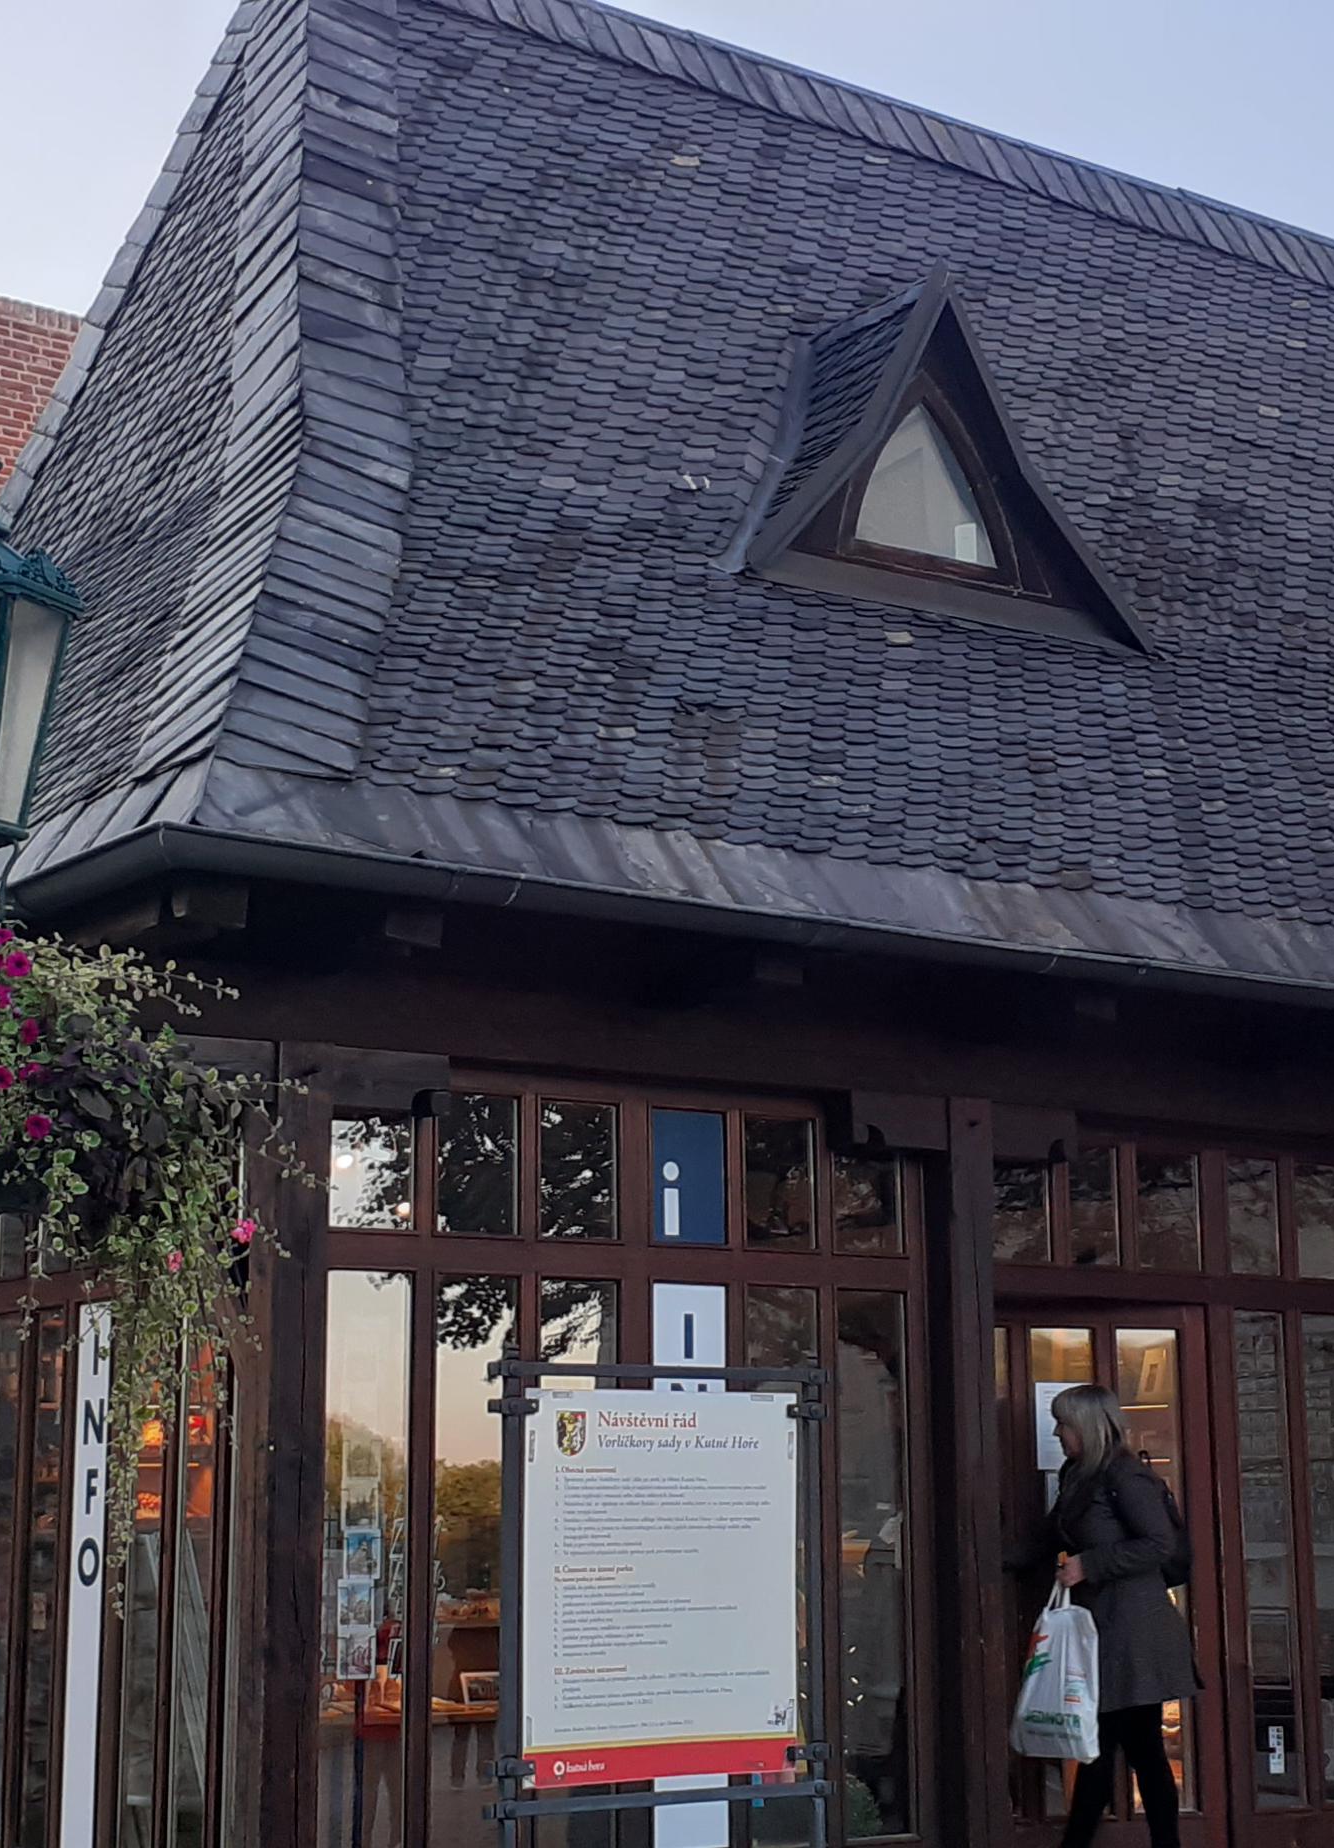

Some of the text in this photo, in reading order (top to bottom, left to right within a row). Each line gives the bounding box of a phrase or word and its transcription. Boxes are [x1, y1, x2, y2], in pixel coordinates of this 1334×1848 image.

[598, 1411, 697, 1429] Návštěvní řád
[597, 1434, 759, 1452] Vorlíčkovy sady v Kutné Hoře
[78, 1329, 105, 1587] INFO
